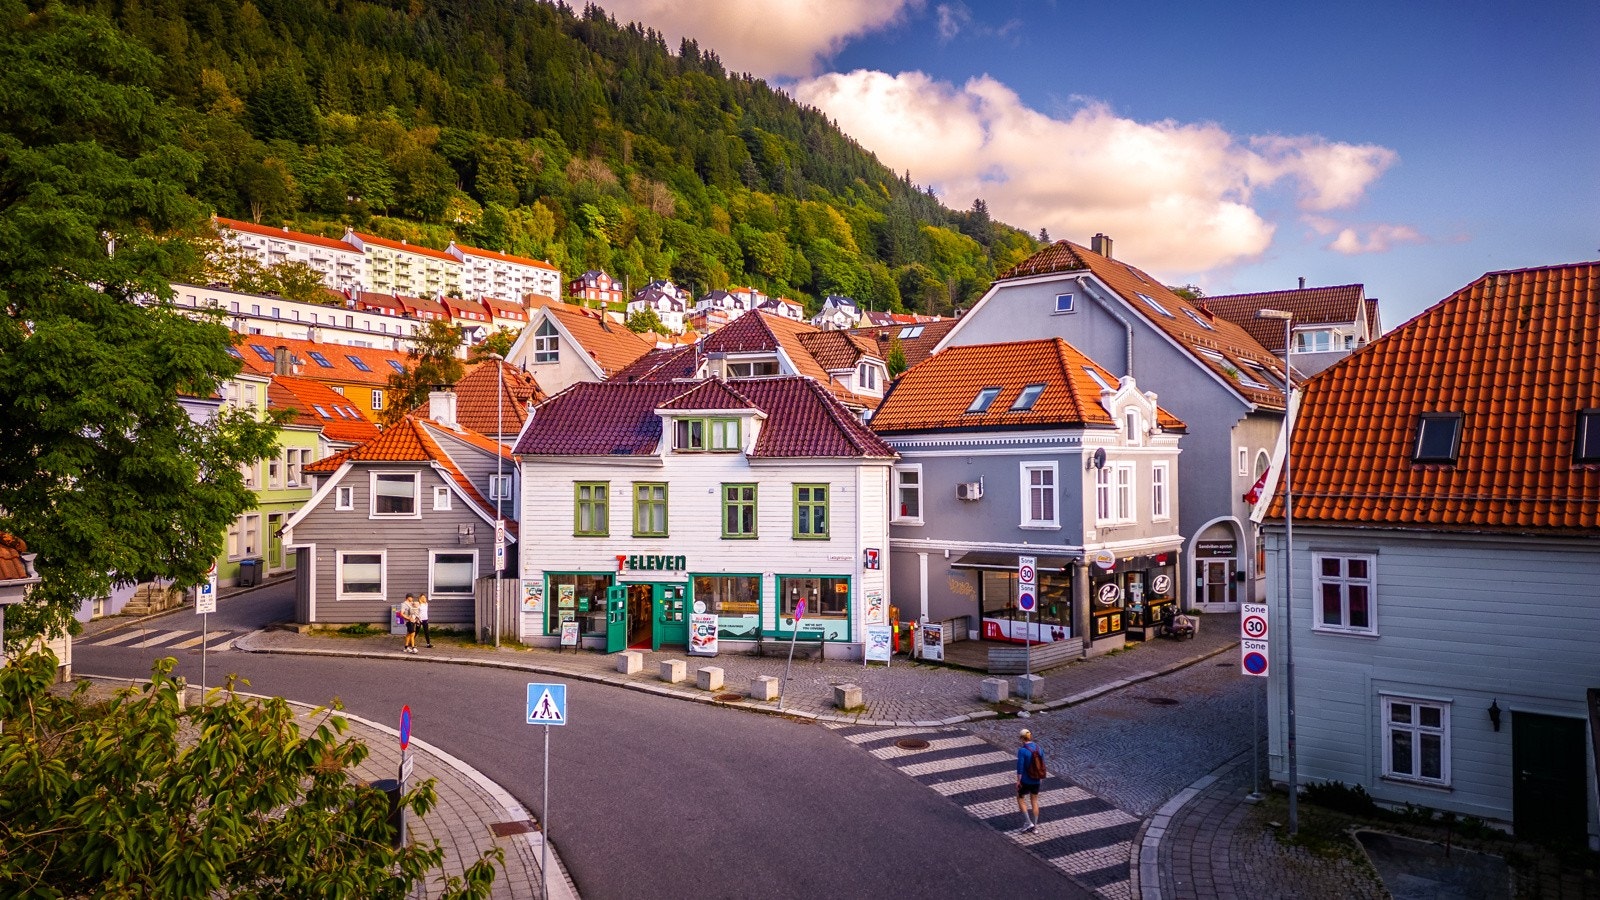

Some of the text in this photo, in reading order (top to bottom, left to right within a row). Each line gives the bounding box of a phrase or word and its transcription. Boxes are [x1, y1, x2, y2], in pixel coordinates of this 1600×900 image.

[1023, 570, 1031, 578] 30
[1244, 604, 1266, 613] Sone
[1248, 621, 1262, 632] 30
[1244, 641, 1266, 650] Sone
